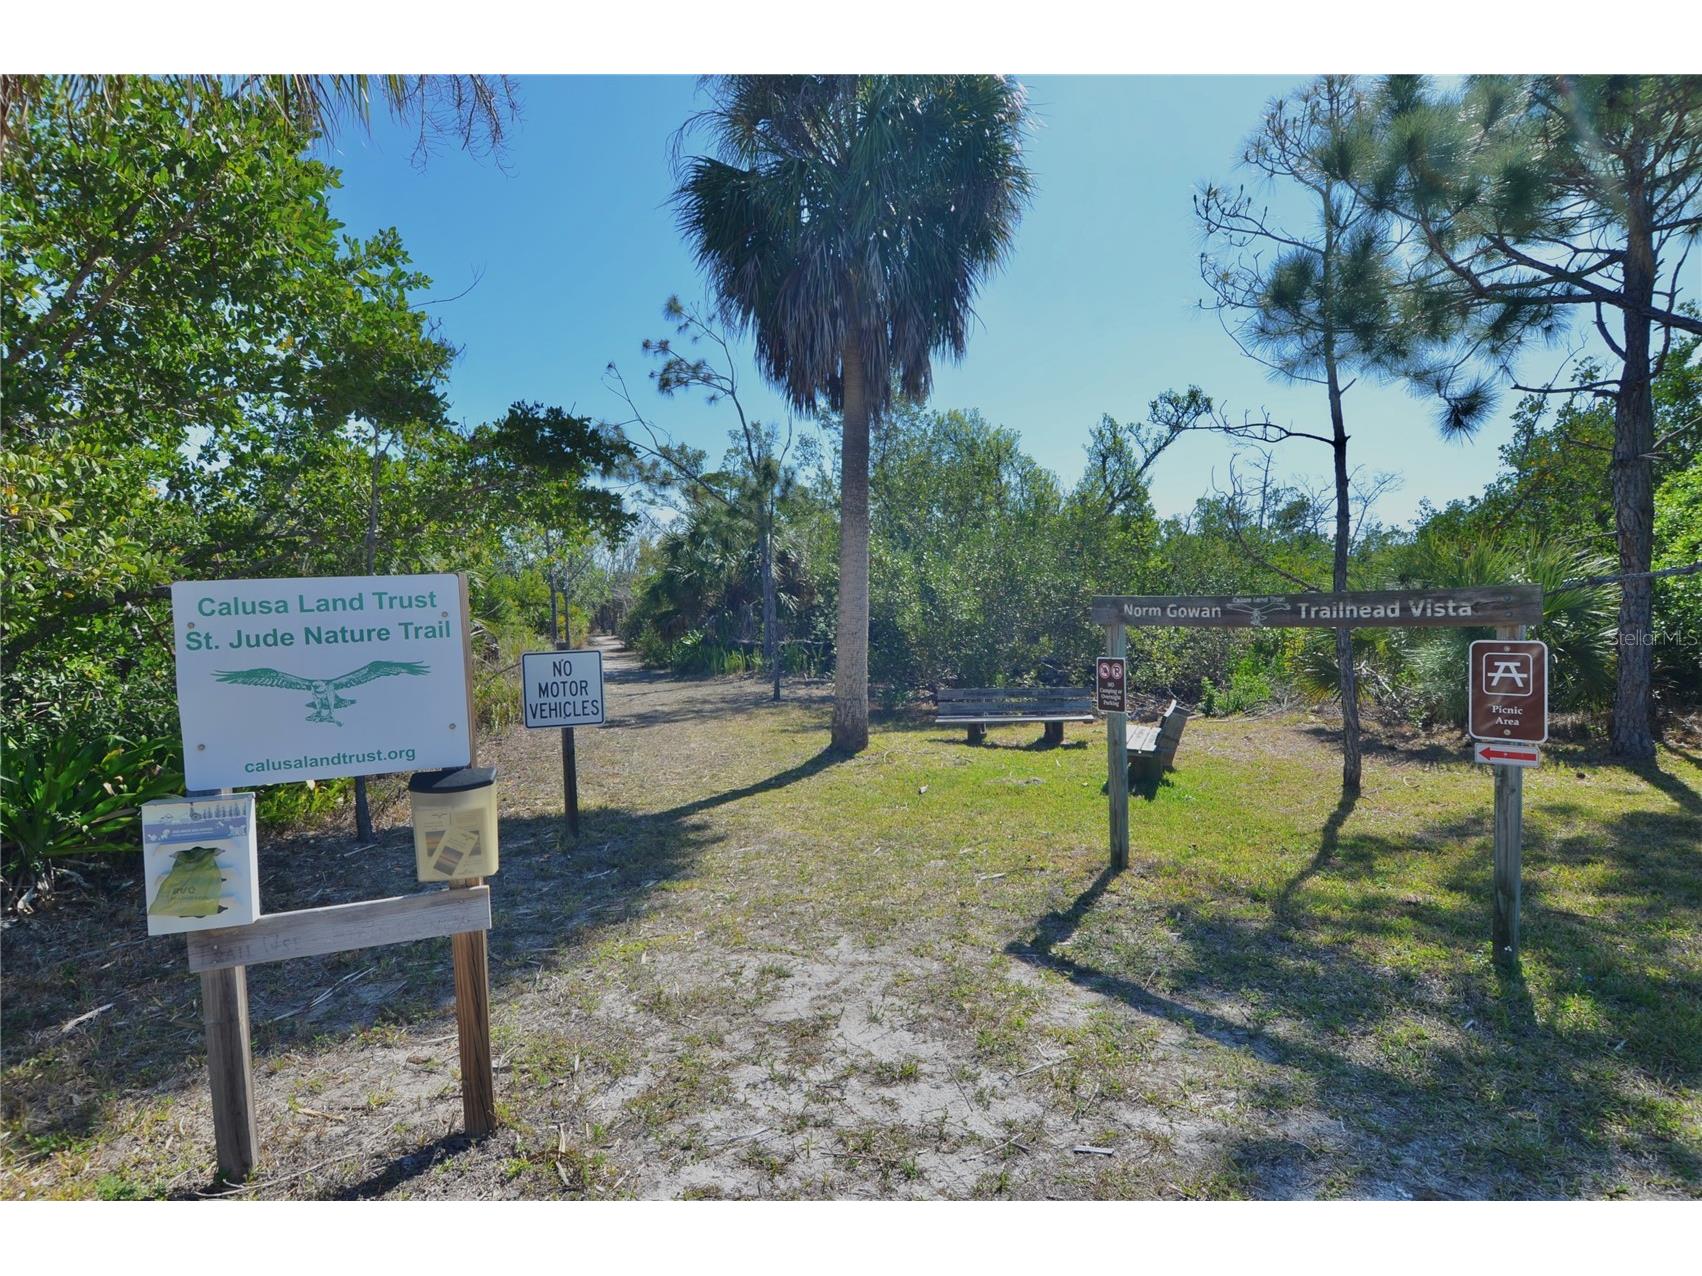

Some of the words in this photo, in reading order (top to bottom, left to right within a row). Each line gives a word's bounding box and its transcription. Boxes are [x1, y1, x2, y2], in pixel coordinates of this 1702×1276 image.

[198, 595, 289, 617] Calusa
[299, 592, 364, 613] Land
[372, 590, 437, 610] Trust
[1123, 603, 1162, 617] Norm
[1166, 604, 1222, 618] Gowan
[1298, 602, 1400, 619] Trailhead
[1408, 599, 1473, 617] Vista
[185, 631, 219, 651] St.
[229, 628, 295, 649] Jude
[304, 624, 391, 645] Nature
[398, 620, 451, 640] Trail
[553, 660, 572, 677] NO
[538, 680, 589, 698] MOTOR
[529, 699, 600, 719] VEHICLES
[1491, 705, 1523, 715] Picnic
[1495, 716, 1520, 726] Area
[244, 748, 416, 774] calusalandtrust.org
